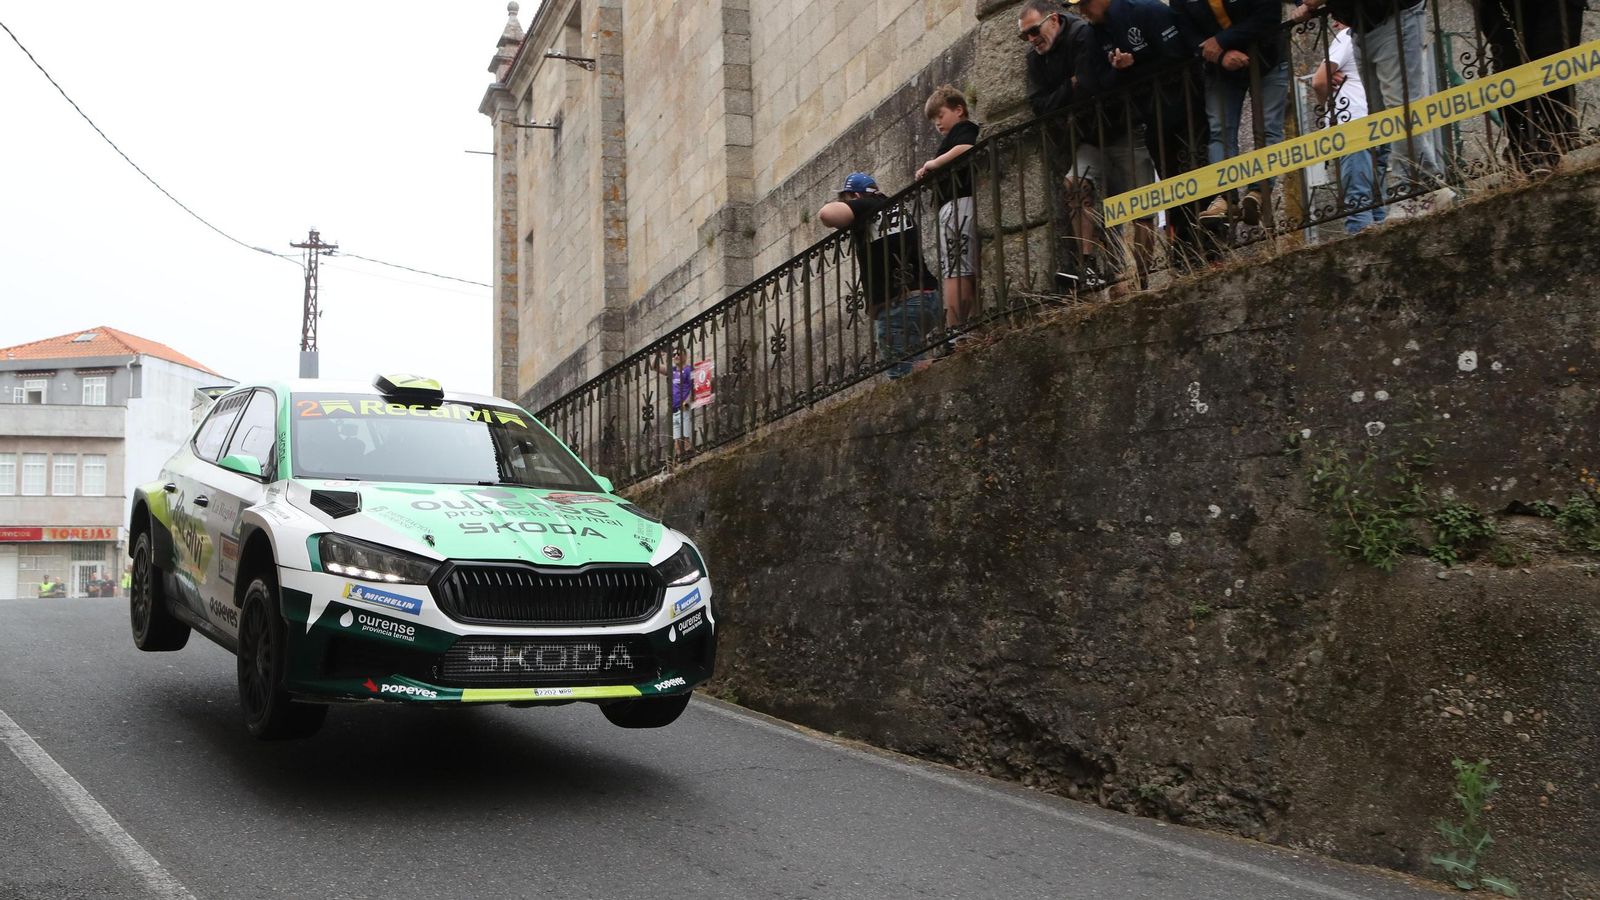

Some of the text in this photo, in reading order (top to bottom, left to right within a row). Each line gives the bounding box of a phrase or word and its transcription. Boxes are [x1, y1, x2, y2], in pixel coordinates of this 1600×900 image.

[1541, 49, 1600, 87] ZONA
[1367, 78, 1516, 141] ZONA PUBLICO
[1216, 132, 1345, 187] ZONA PUBLICO
[1130, 178, 1198, 214] PUBLICO
[297, 400, 322, 417] 2
[411, 499, 609, 518] ourense
[50, 528, 112, 540] TOREJAS
[458, 521, 609, 539] SKODA
[364, 592, 416, 610] MICHELIN
[358, 614, 416, 636] ourense
[678, 612, 702, 631] ourense
[362, 624, 416, 642] provincia termal
[467, 643, 634, 672] SKODA
